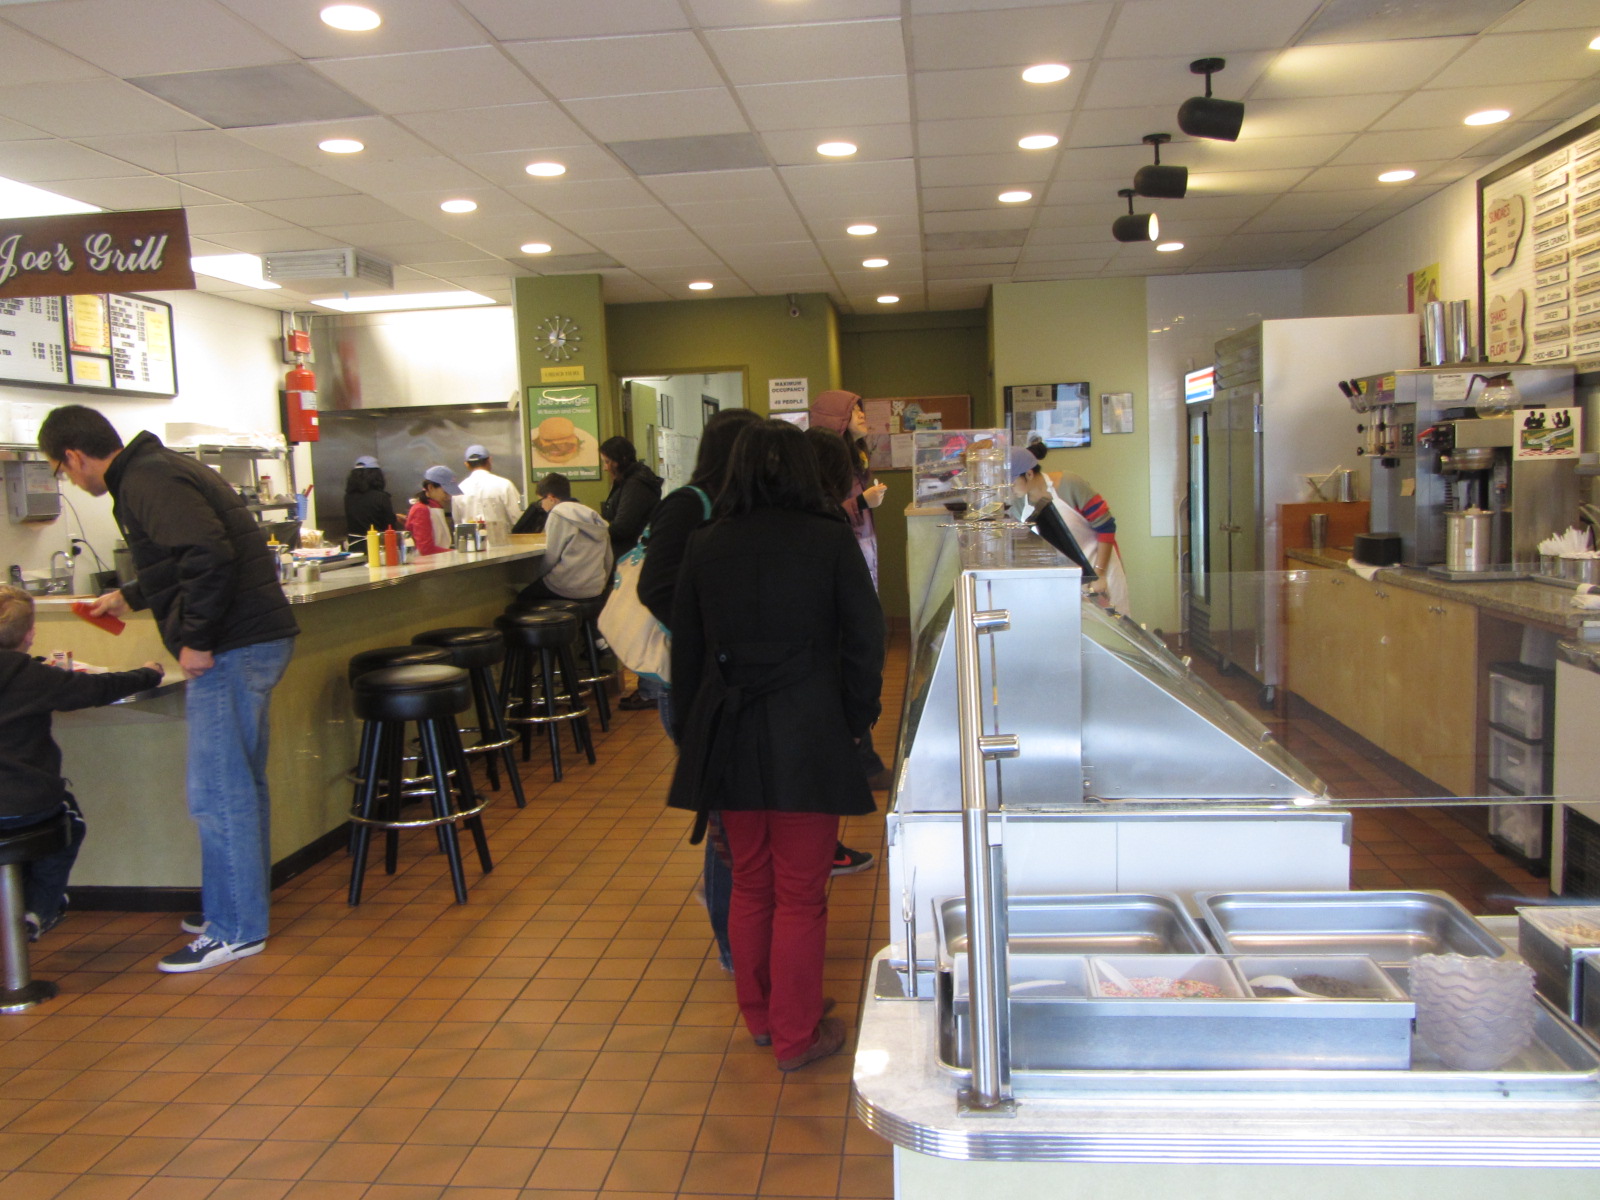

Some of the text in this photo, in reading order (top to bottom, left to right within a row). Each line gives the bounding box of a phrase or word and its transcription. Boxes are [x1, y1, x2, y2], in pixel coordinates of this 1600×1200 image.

[1488, 203, 1510, 224] SUNDAES
[0, 233, 168, 285] Joe's Grill
[1490, 342, 1508, 357] FLOAT
